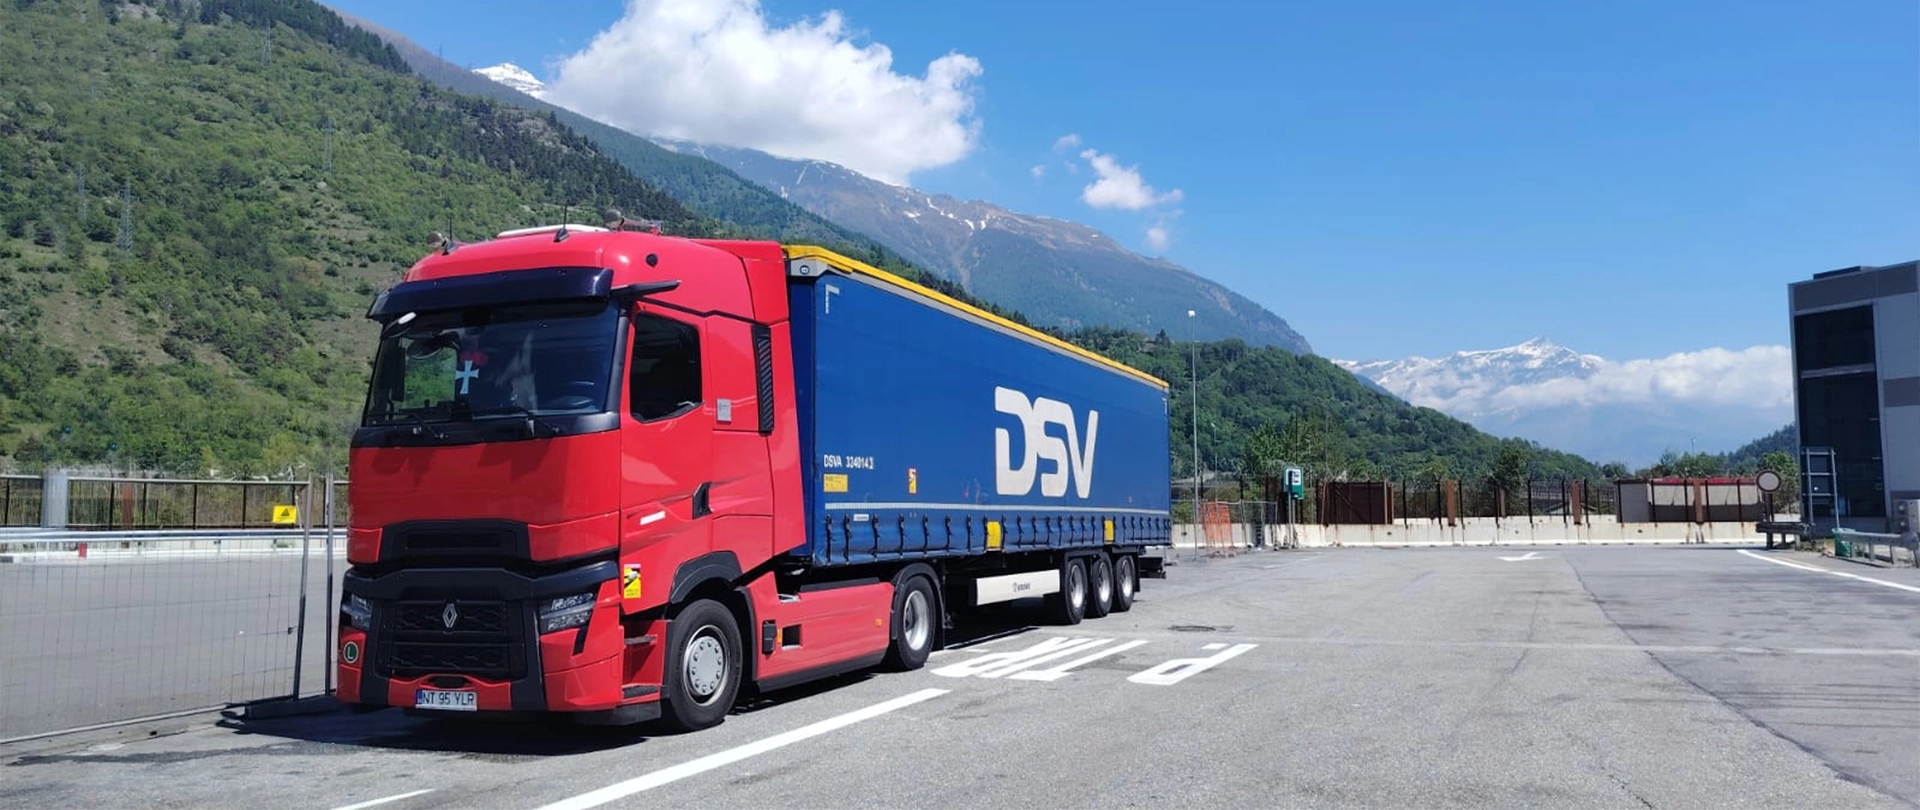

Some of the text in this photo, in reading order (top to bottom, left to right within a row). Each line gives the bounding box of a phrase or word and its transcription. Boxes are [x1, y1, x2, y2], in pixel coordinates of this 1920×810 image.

[995, 386, 1098, 499] DSV
[824, 454, 842, 467] DSVA
[423, 692, 474, 706] NT 95 YLR
